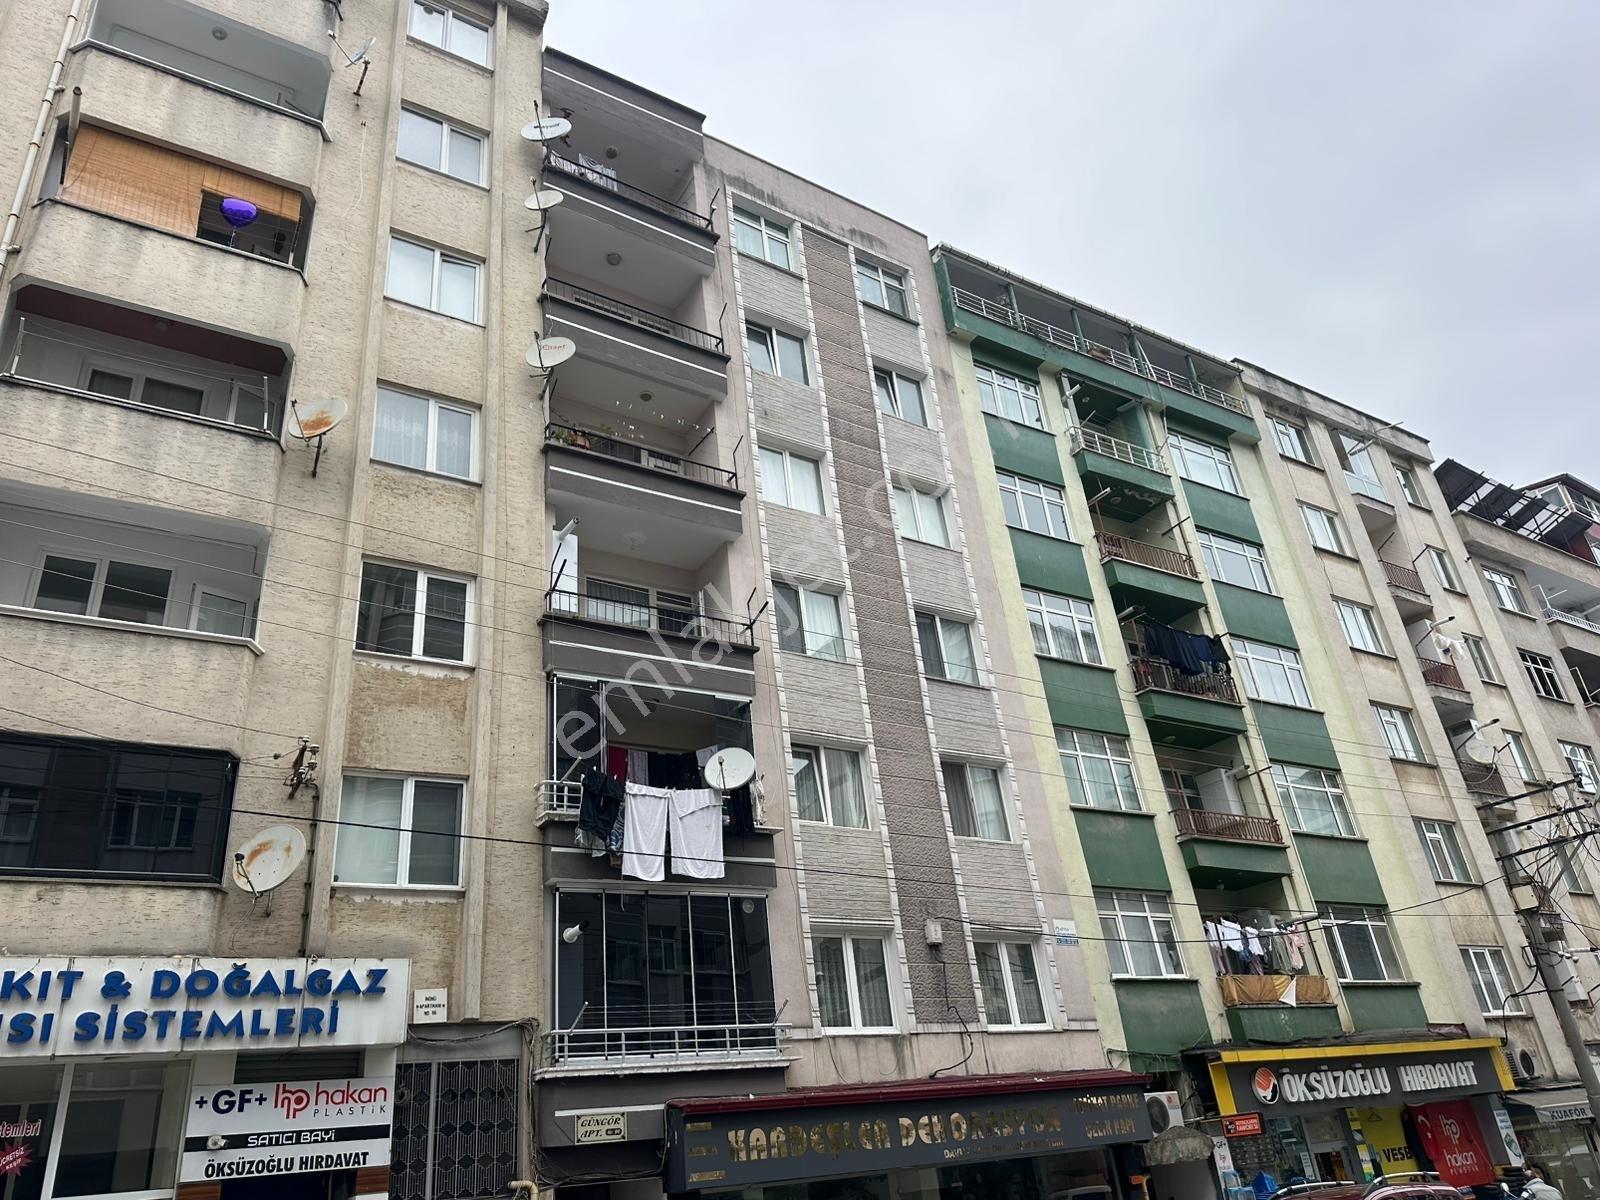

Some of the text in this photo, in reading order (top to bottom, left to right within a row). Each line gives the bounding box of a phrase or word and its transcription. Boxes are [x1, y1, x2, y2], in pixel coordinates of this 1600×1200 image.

[0, 963, 388, 1001] KIT & DOĞALGAZ
[0, 1000, 339, 1044] SI SİSTEMLERİ
[315, 1081, 387, 1106] hakan
[1279, 1061, 1478, 1102] ÖKSÜZOĞLU HIRDAVAT
[0, 1119, 41, 1137] temleri
[247, 1132, 296, 1147] SATICI
[204, 1151, 369, 1178] ÖKSÜZOĞLU HIRDAVAT
[1444, 1147, 1477, 1168] hakan
